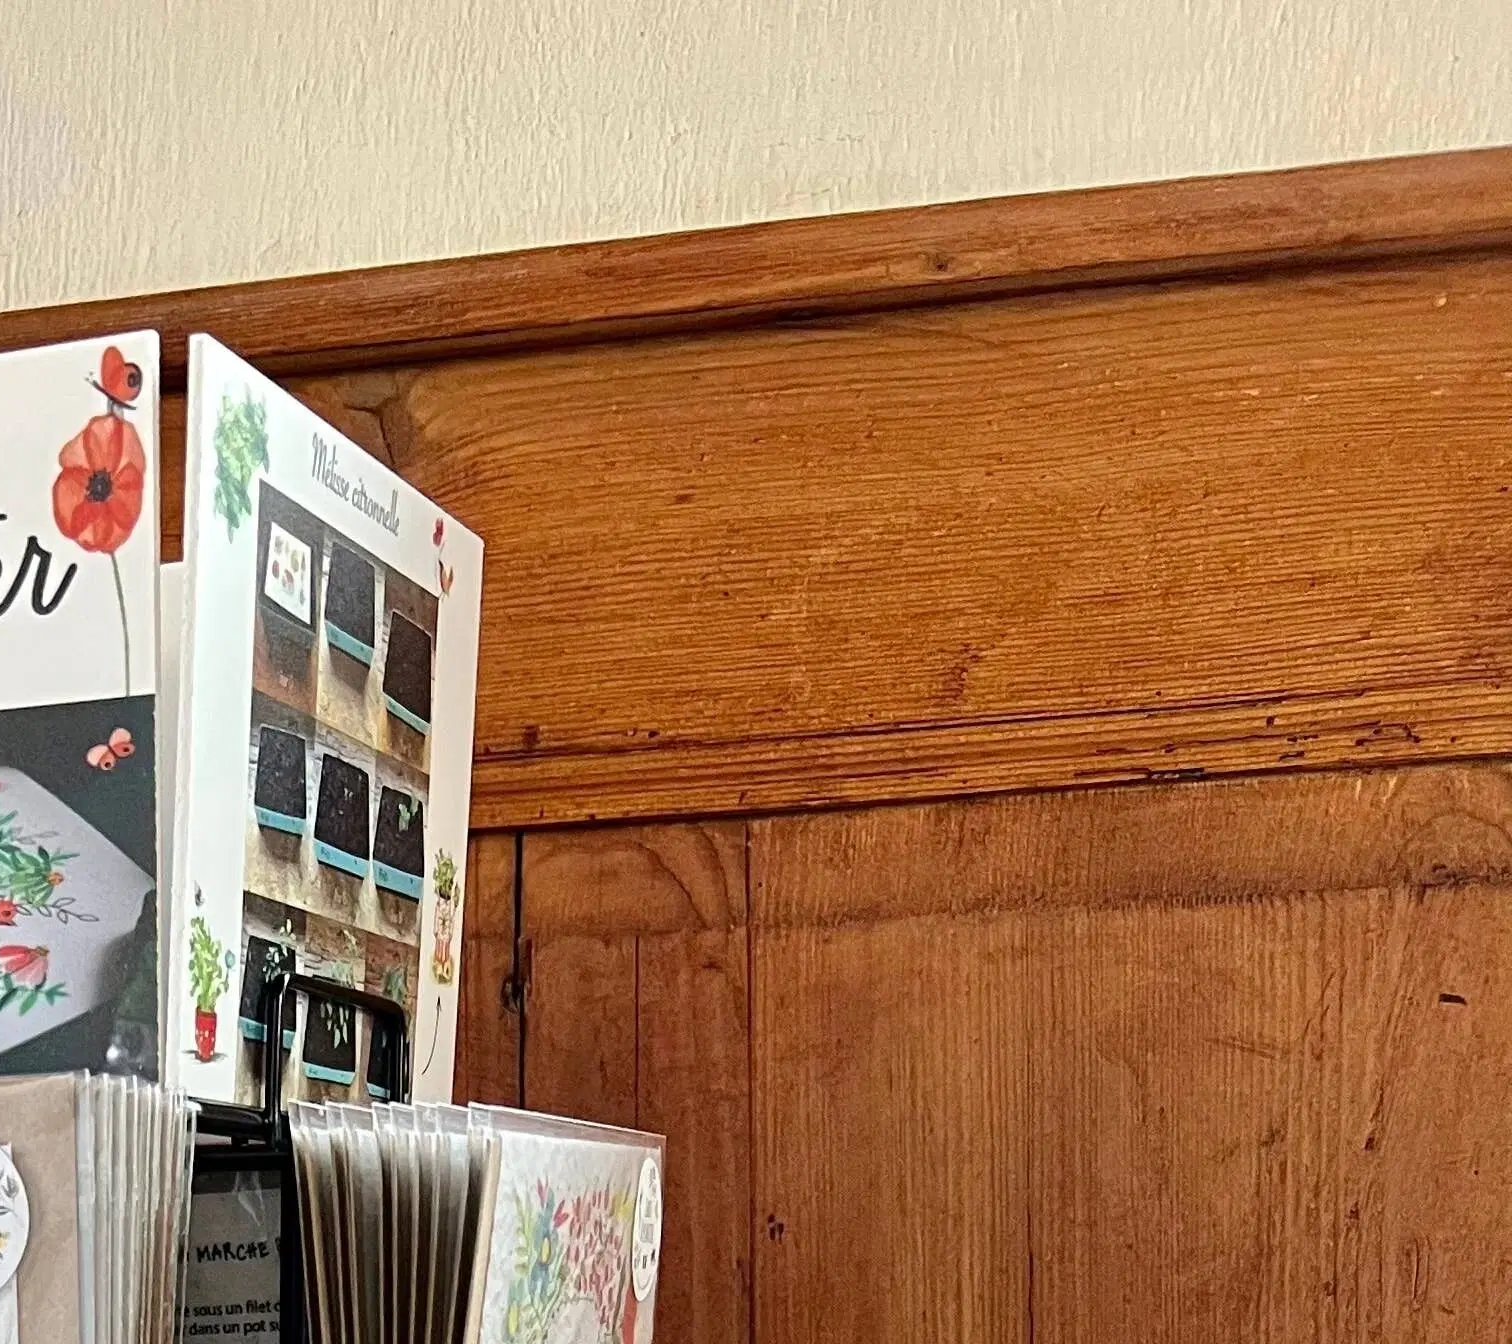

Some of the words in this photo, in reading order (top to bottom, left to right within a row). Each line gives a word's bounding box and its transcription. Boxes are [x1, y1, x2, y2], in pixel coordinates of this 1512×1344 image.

[311, 431, 350, 502] Mélisse
[351, 476, 400, 537] citronnelle
[196, 1239, 270, 1264] MARCHE
[193, 1303, 223, 1317] sous
[225, 1302, 243, 1316] un
[246, 1298, 272, 1314] filet
[189, 1322, 220, 1336] dans
[223, 1322, 240, 1335] un
[243, 1320, 266, 1336] pot
